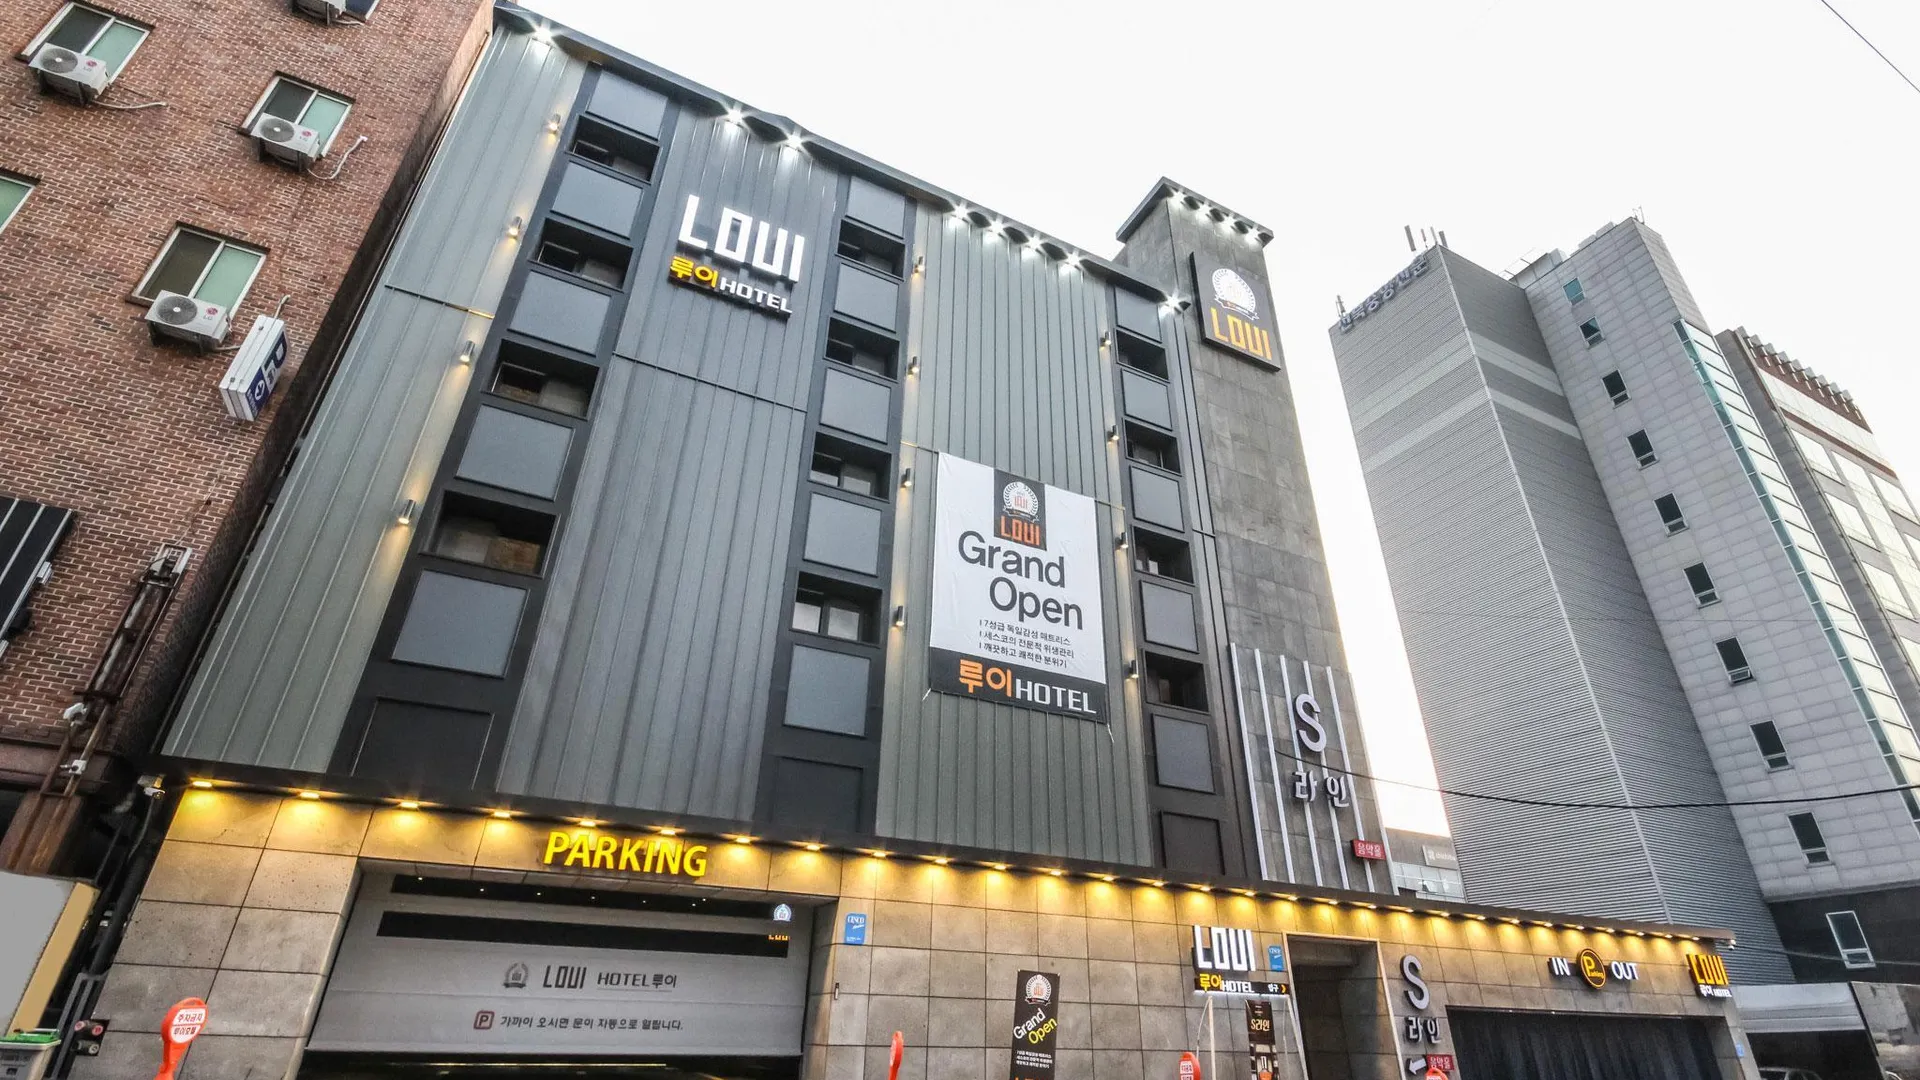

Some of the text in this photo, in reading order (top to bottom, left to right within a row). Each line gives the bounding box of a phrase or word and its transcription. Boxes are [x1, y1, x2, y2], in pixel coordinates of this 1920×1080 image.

[678, 194, 805, 283] LOUI
[670, 256, 793, 313] 루이 HOTEL
[1210, 307, 1272, 360] LOUI
[1001, 515, 1040, 546] LOUI
[958, 530, 1066, 588] Grand
[989, 576, 1083, 630] Open
[984, 631, 1074, 658] 세스코의 전문적 위생관리
[1007, 624, 1038, 639] 독일감성
[1040, 632, 1071, 646] 매트리스
[1044, 656, 1067, 668] 분위기
[959, 659, 1097, 714] 루이 HOTEL
[1295, 693, 1327, 752] S
[1294, 770, 1350, 808] 라인
[543, 831, 708, 877] PARKING
[1194, 925, 1256, 972] LOUI
[543, 965, 677, 989] LOUI HOTEL 루이
[1200, 973, 1222, 992] 루이
[1222, 980, 1255, 993] HOTEL
[1403, 954, 1430, 1010] S
[1552, 957, 1571, 976] IN
[1611, 961, 1639, 980] OUT
[1689, 954, 1729, 985] LOUI
[500, 1016, 533, 1028] 가까이
[536, 1017, 570, 1029] 오시면
[573, 1018, 594, 1029] 문이
[597, 1018, 638, 1030] 자동으로
[642, 1019, 683, 1031] 열립니다.
[1013, 1008, 1046, 1039] Grand
[1028, 1017, 1057, 1044] Open
[1408, 1017, 1441, 1043] 라인
